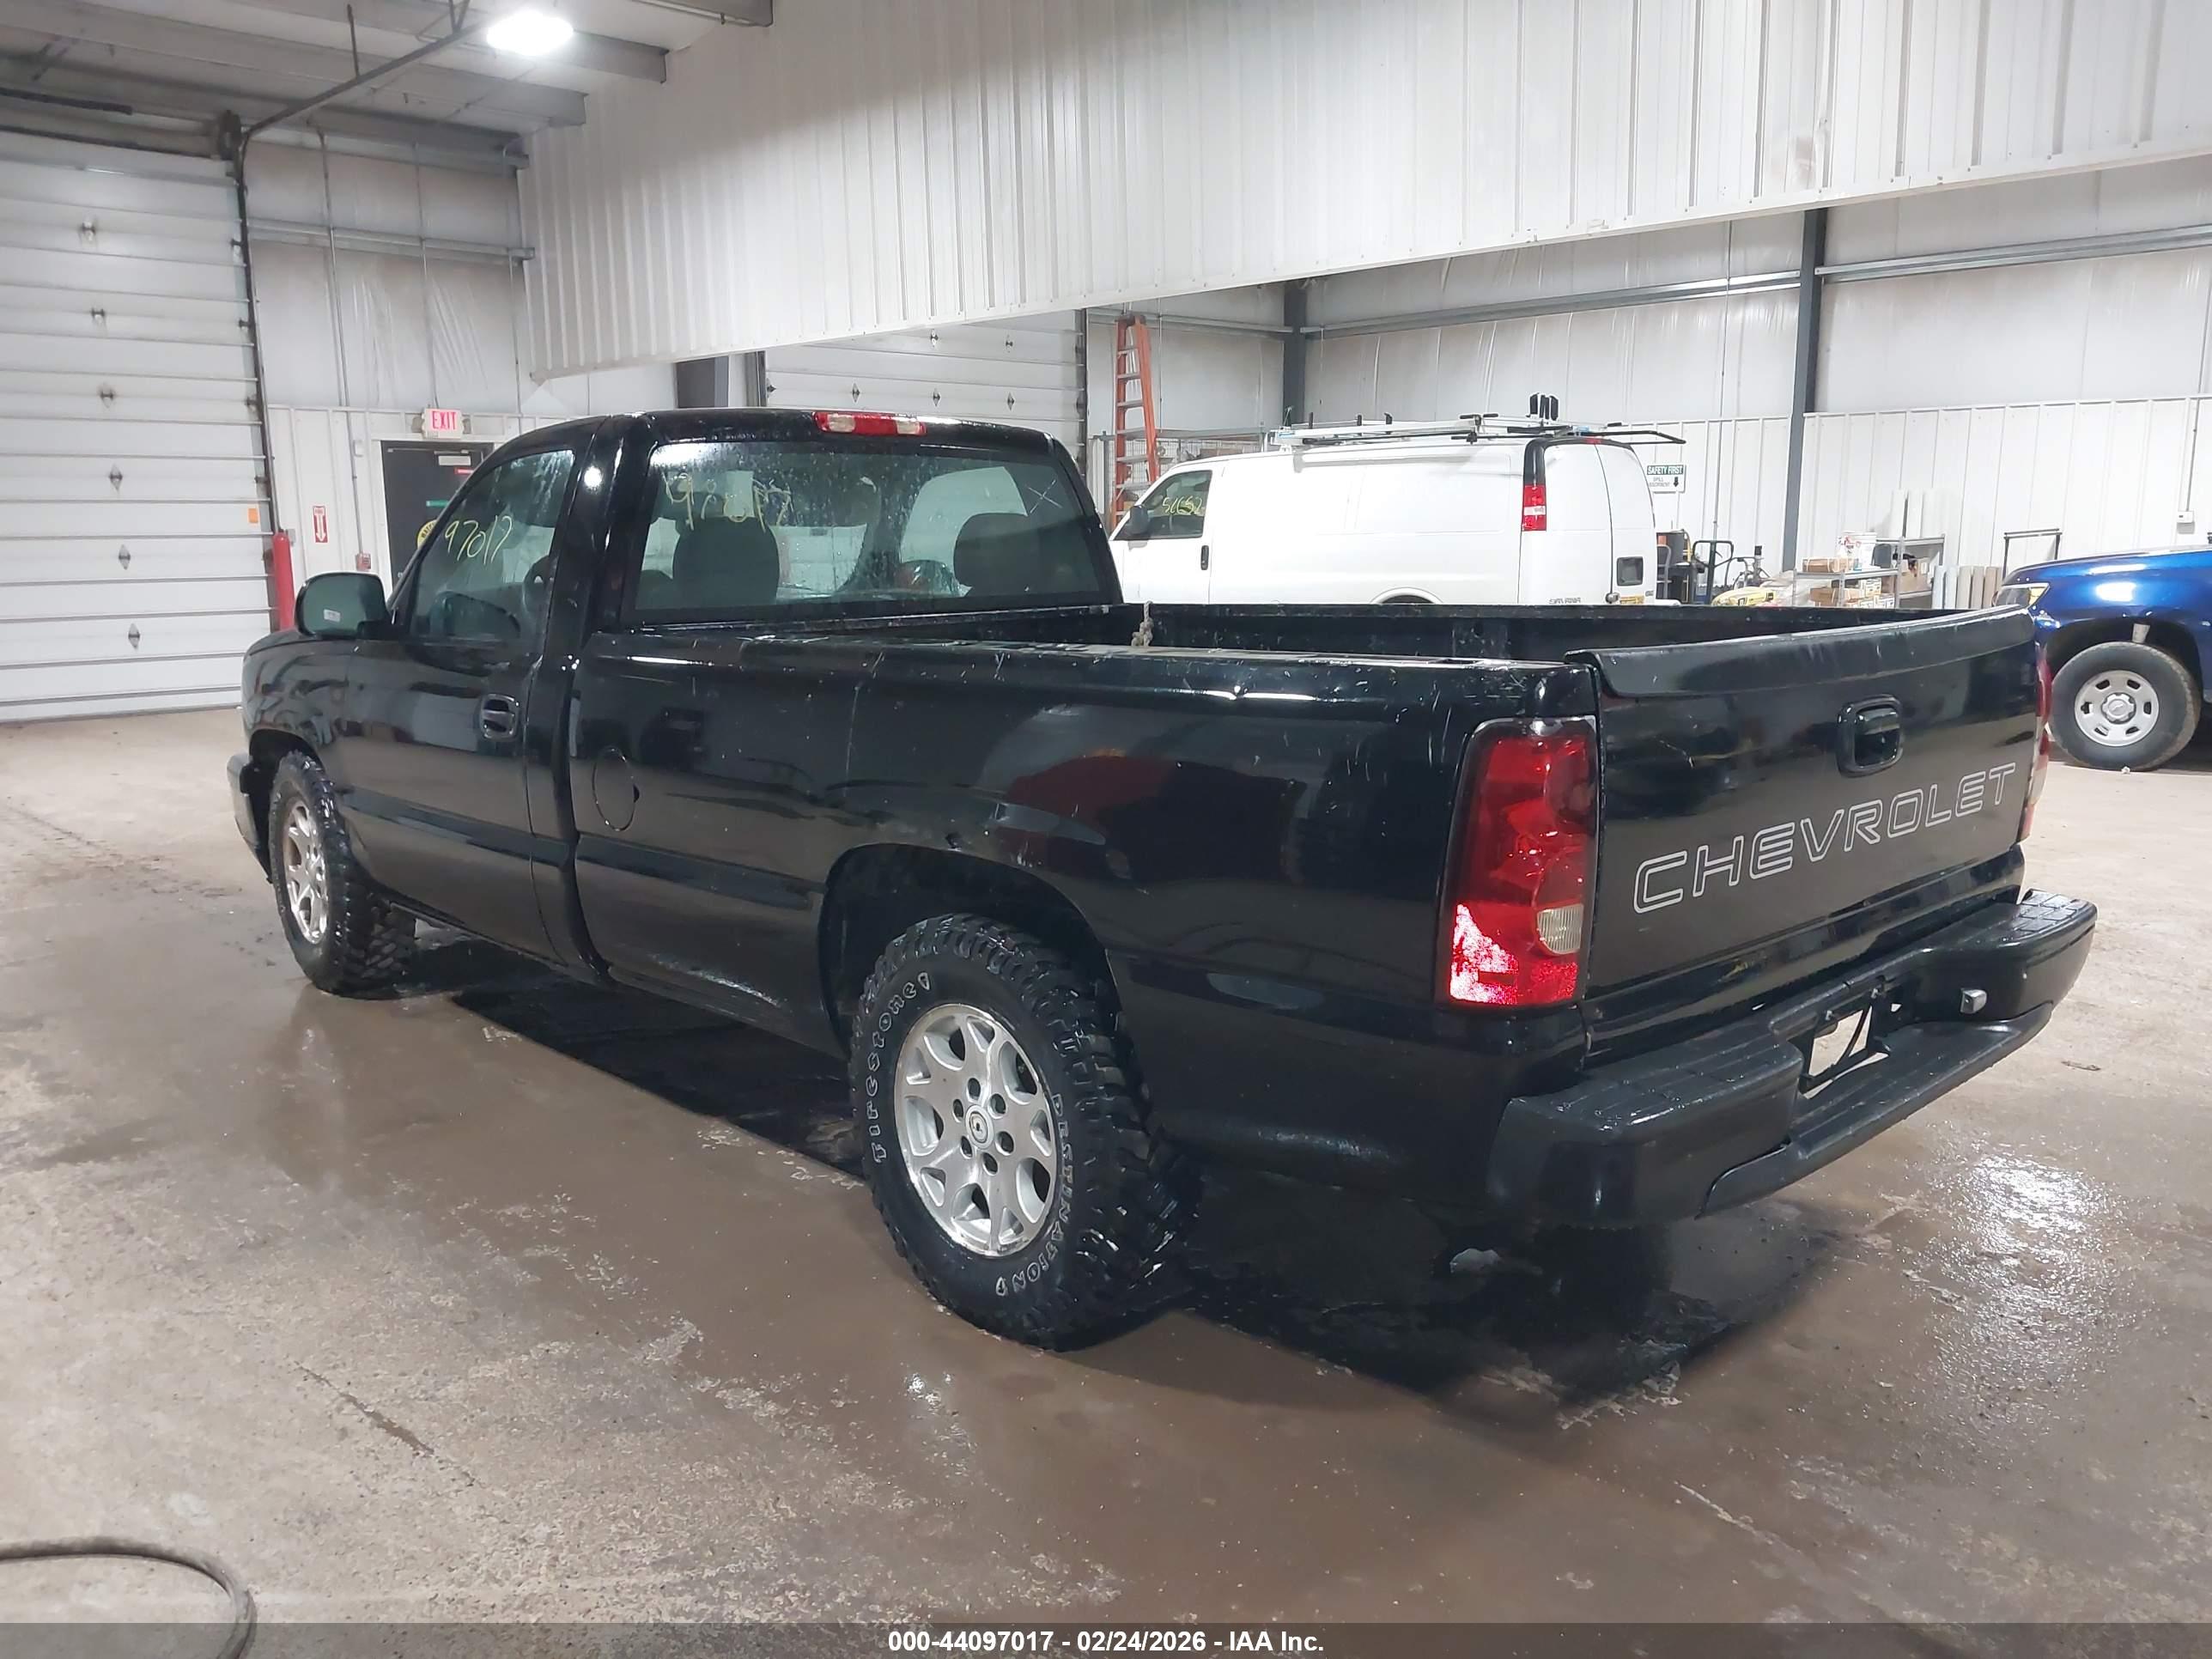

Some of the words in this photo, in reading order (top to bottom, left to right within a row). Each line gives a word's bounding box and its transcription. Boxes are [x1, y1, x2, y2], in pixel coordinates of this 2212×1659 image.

[432, 410, 457, 430] EXIT
[1648, 465, 1668, 475] SAFETY
[1668, 465, 1683, 475] FIRST
[445, 514, 513, 567] 97017
[1632, 763, 2016, 915] CHEVROLET
[1012, 1093, 1073, 1292] DESTINATION
